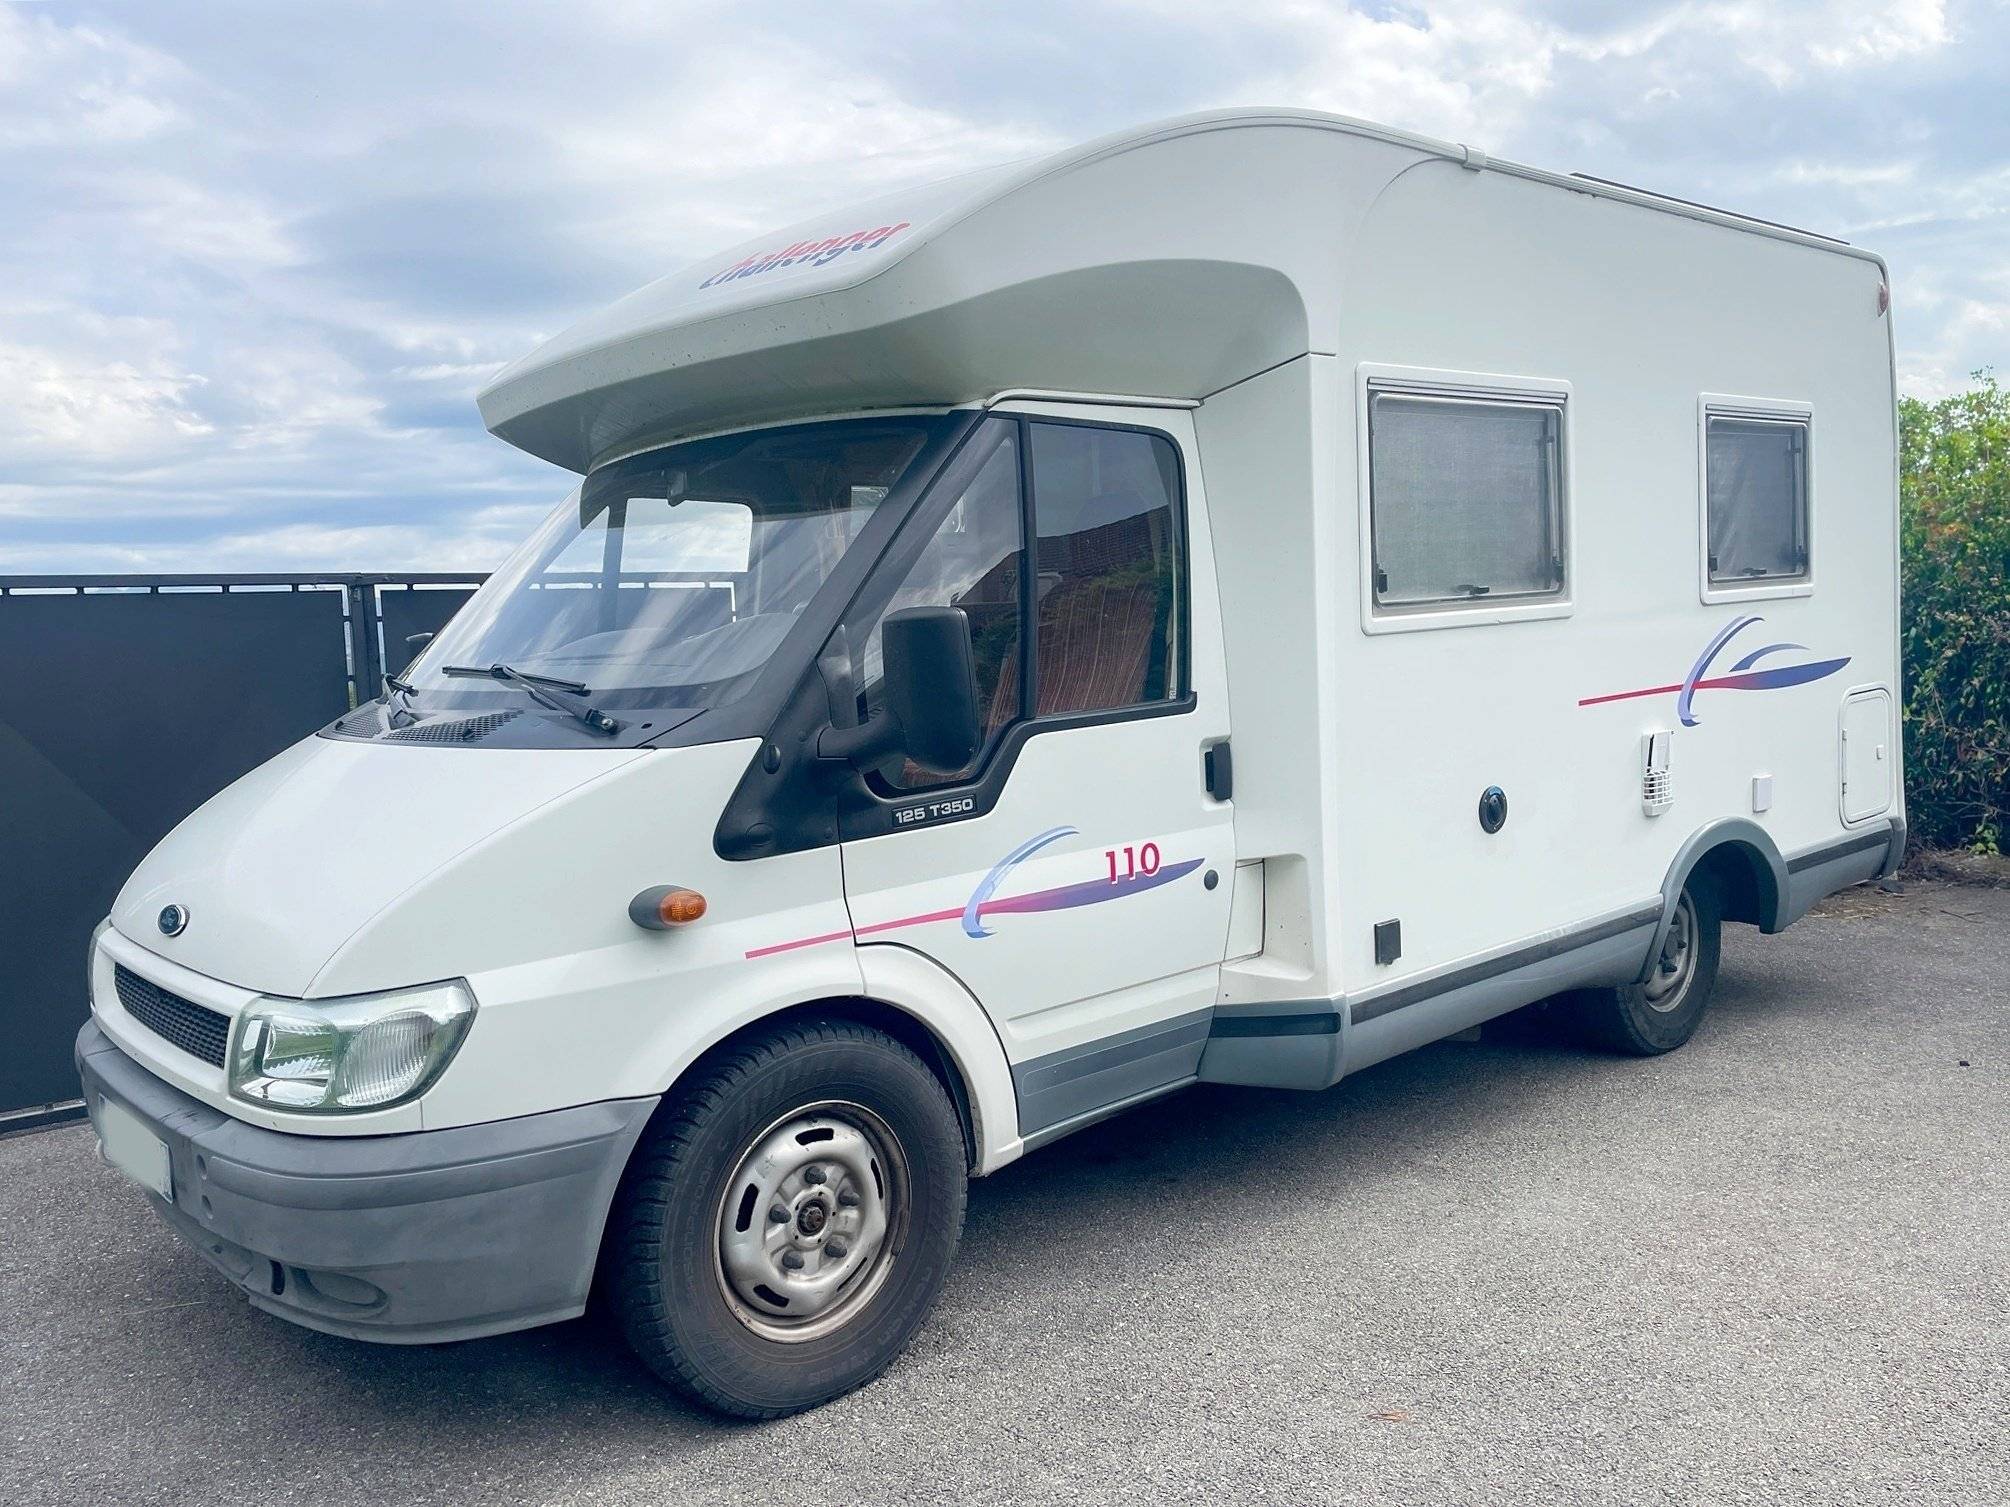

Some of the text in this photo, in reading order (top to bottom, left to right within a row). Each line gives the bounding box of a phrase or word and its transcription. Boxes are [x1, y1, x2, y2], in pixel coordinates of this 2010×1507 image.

[896, 798, 974, 824] 125 T350
[1105, 842, 1161, 883] 110
